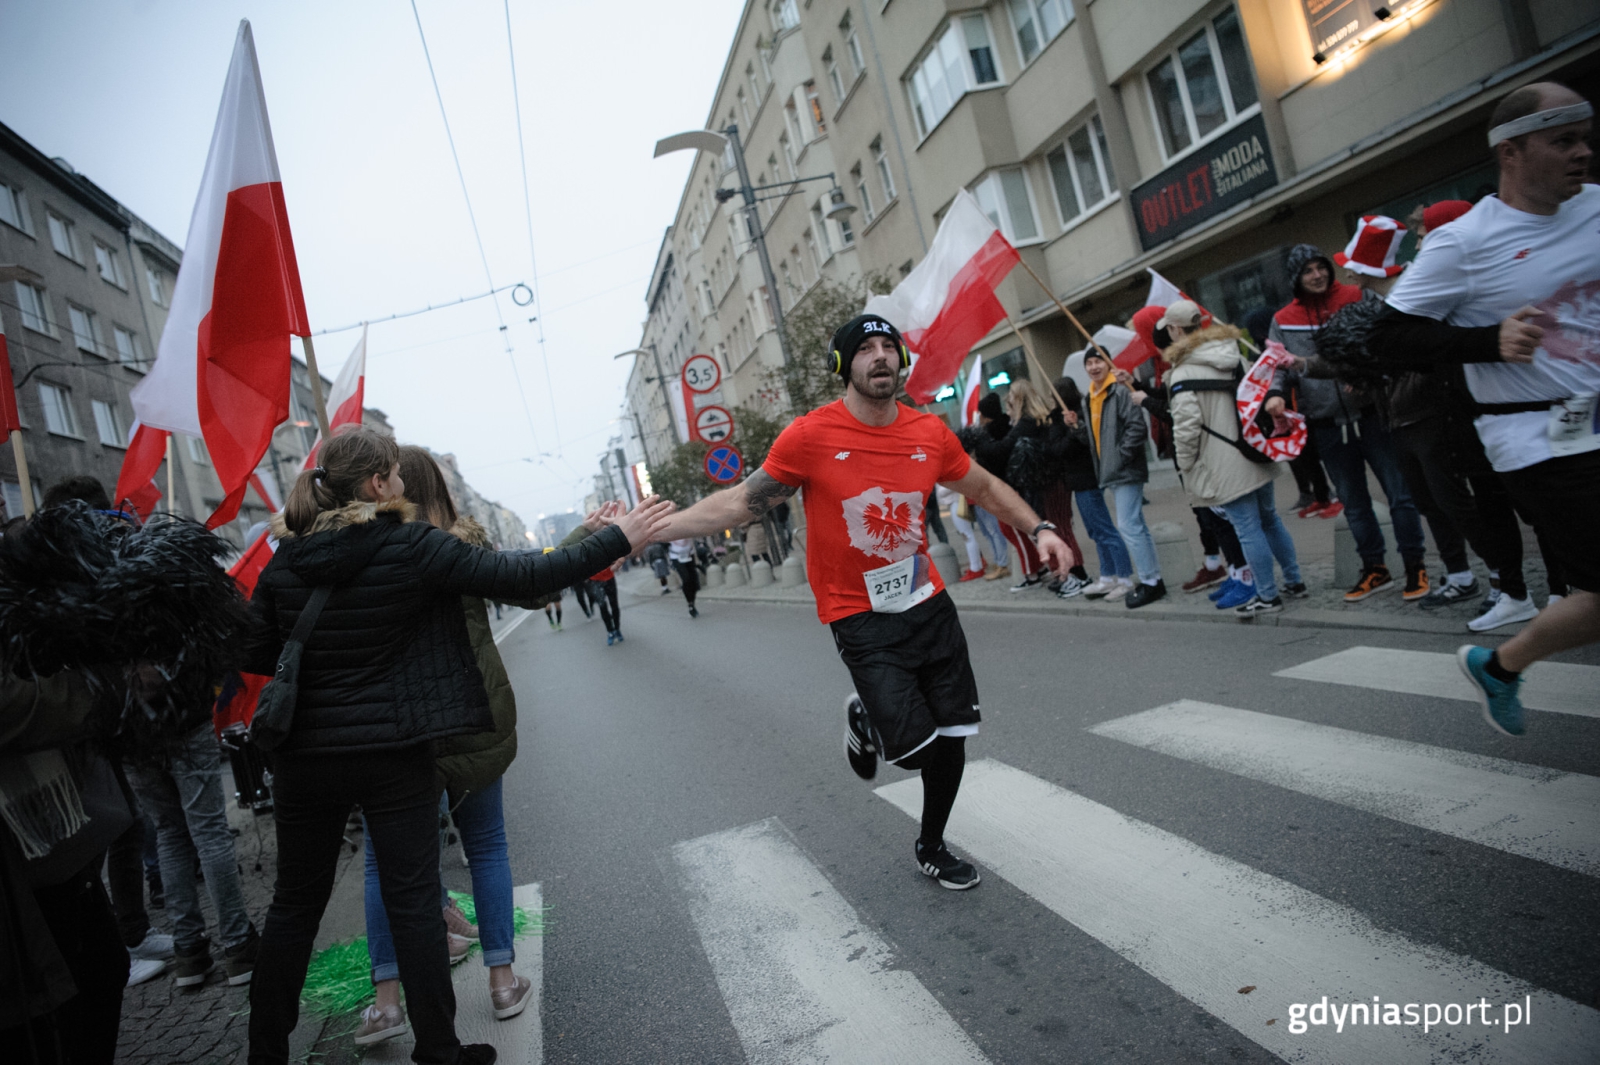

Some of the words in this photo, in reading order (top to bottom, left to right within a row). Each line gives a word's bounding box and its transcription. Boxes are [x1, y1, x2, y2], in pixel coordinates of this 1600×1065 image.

[1217, 135, 1264, 177] MODA
[1222, 158, 1269, 195] ITALIANA
[1141, 164, 1212, 233] OUTLET
[863, 321, 892, 334] 3LK
[835, 451, 850, 460] 4F
[875, 574, 908, 595] 2737
